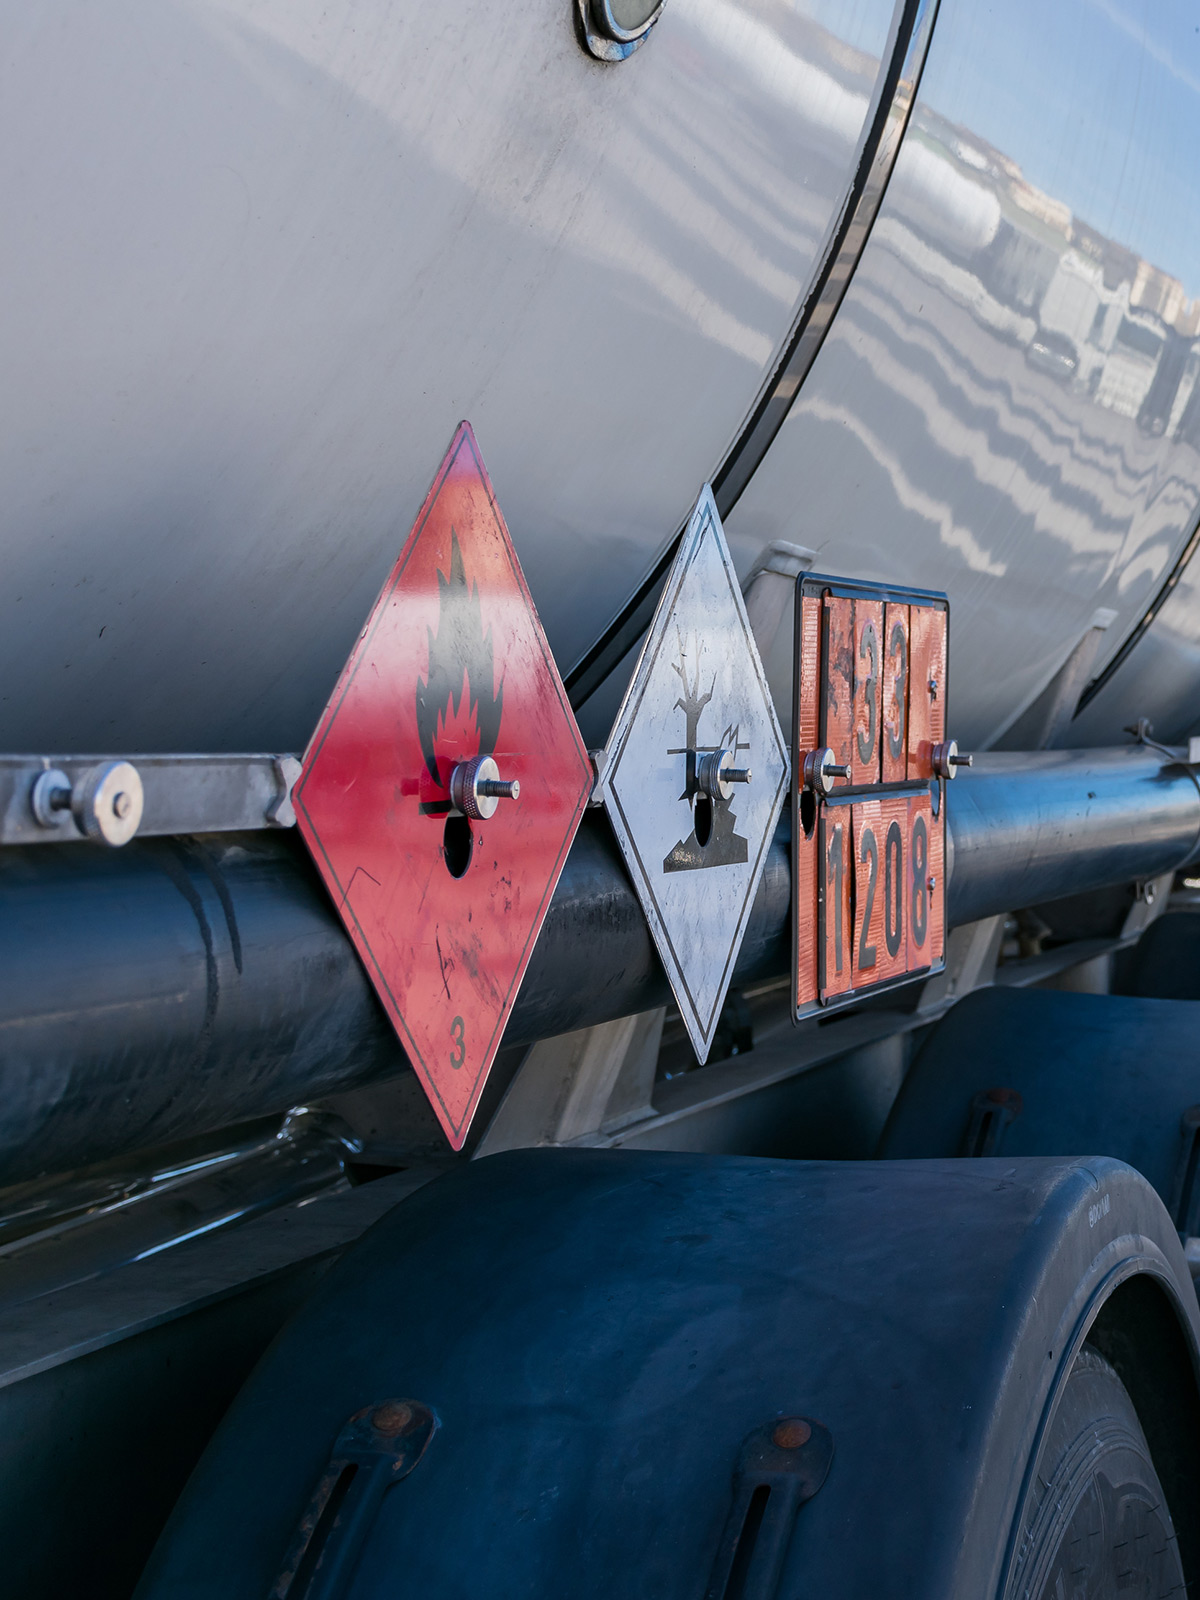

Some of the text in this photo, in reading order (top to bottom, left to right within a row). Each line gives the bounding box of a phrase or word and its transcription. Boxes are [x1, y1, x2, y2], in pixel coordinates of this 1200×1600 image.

[858, 623, 907, 765] 33
[828, 815, 928, 972] 1208
[450, 1015, 466, 1070] 3
